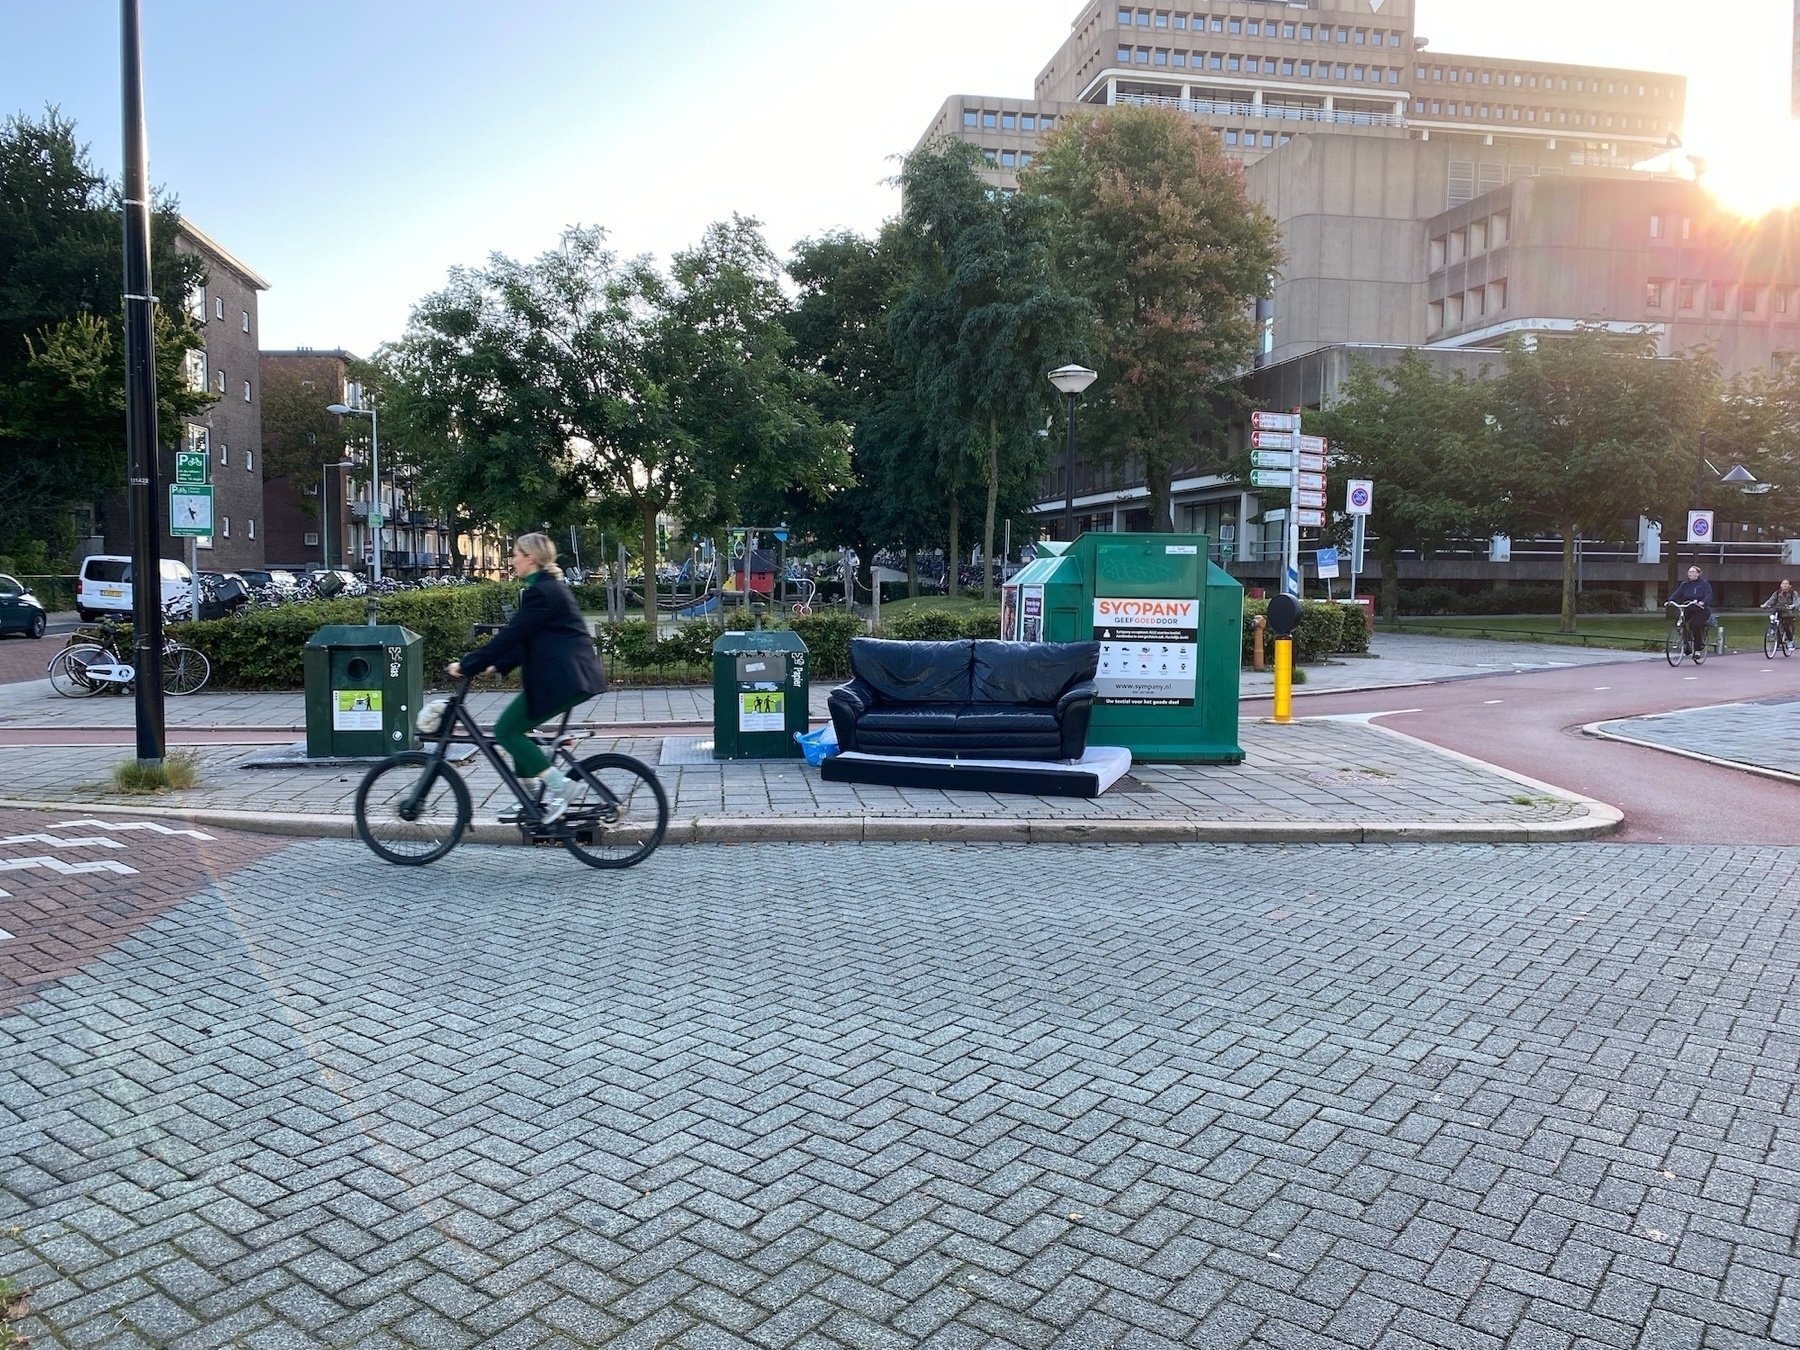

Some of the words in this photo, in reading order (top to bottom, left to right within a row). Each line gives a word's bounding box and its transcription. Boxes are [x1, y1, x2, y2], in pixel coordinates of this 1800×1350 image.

[179, 454, 188, 466] P
[171, 485, 178, 494] P
[1099, 601, 1193, 616] SYMPANY
[390, 662, 401, 678] Glas
[791, 667, 804, 688] Papier
[1115, 683, 1172, 691] www.sympany.nl
